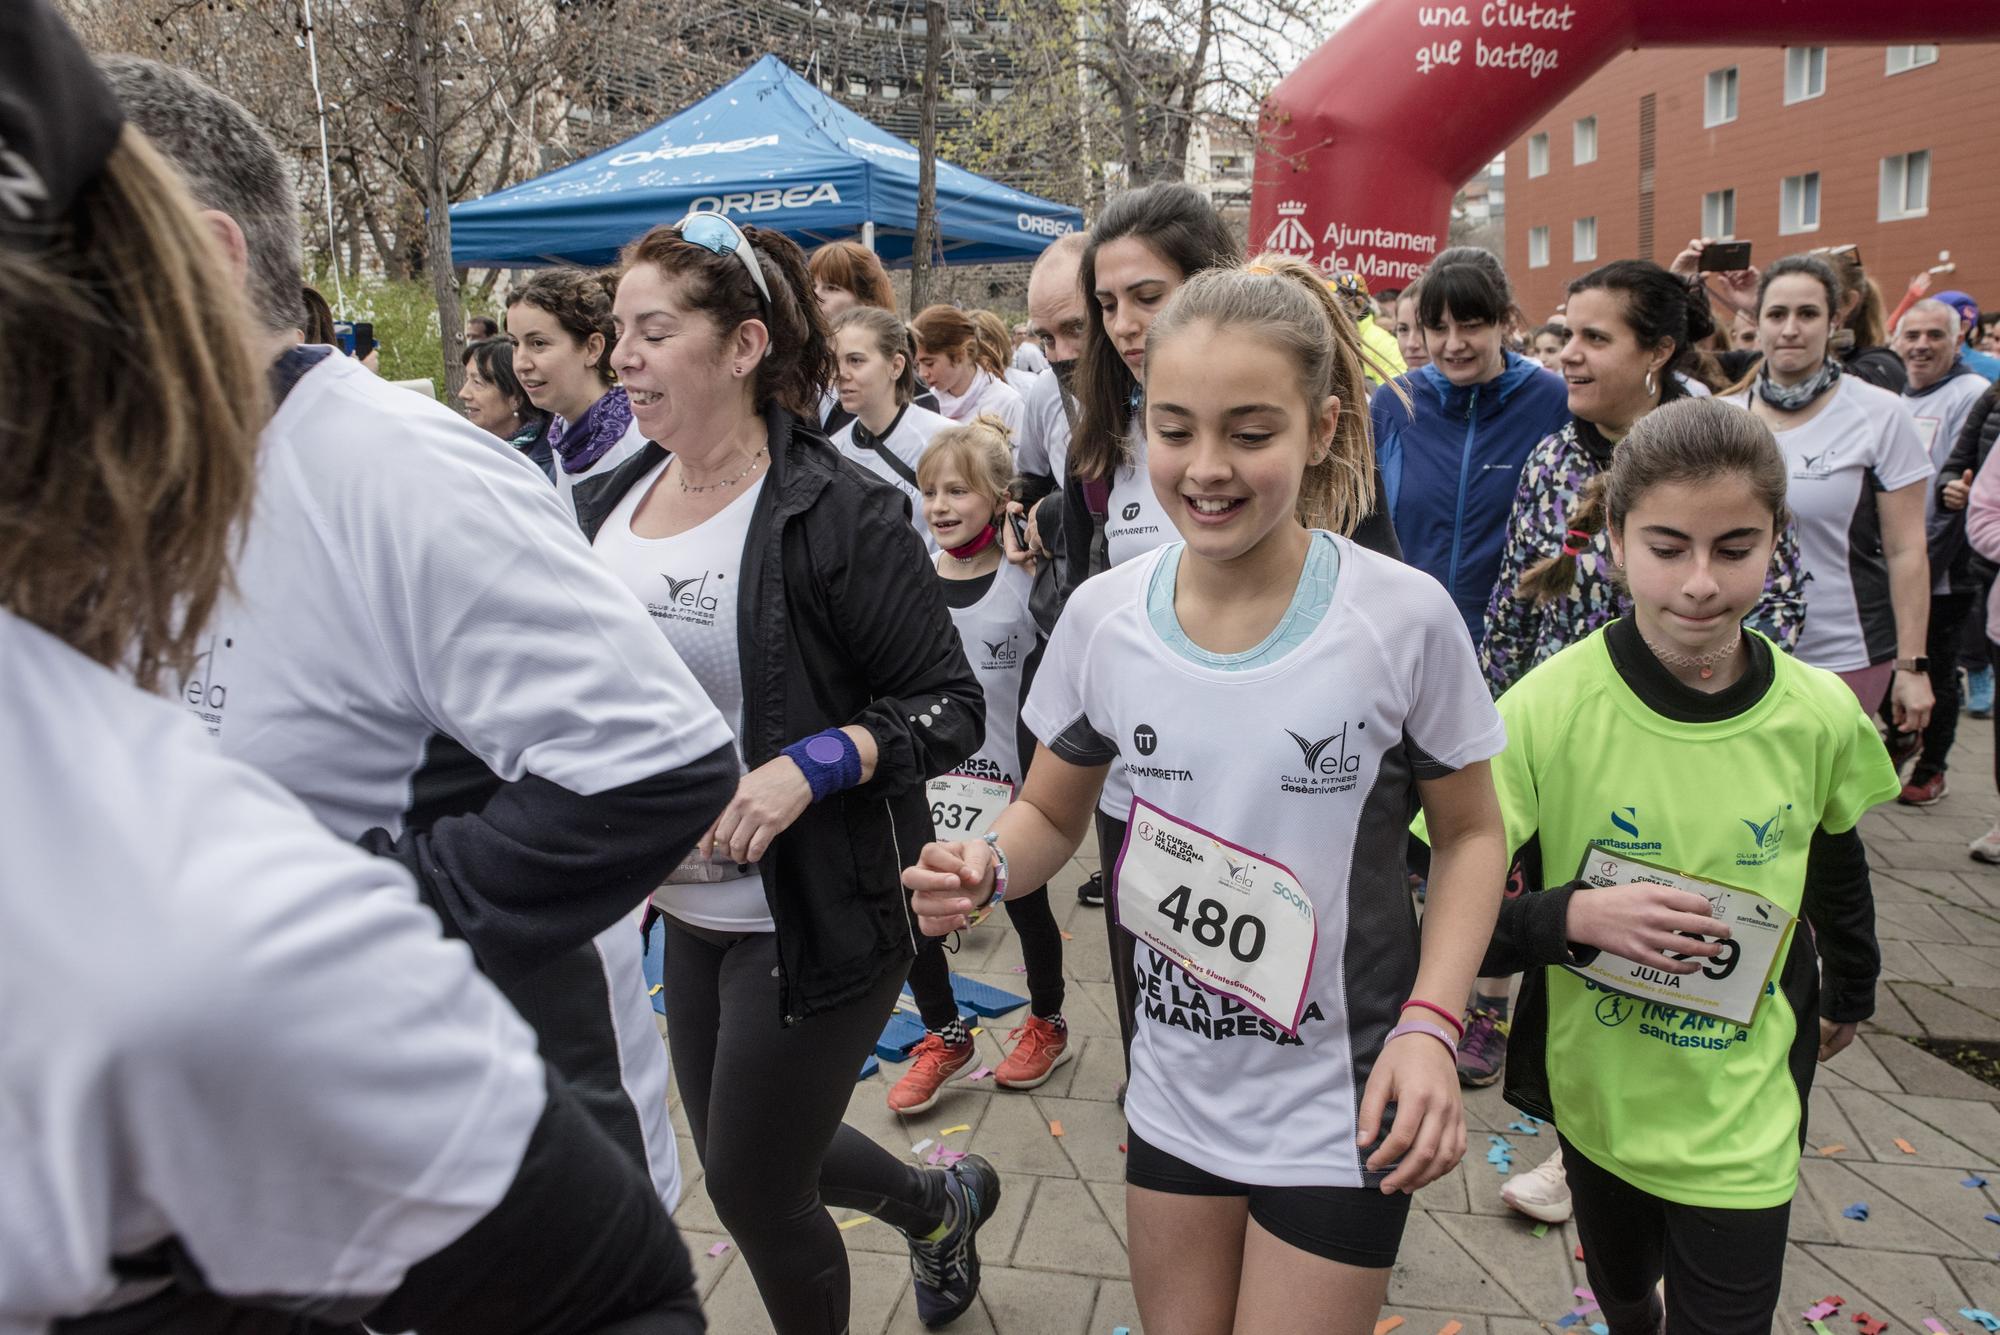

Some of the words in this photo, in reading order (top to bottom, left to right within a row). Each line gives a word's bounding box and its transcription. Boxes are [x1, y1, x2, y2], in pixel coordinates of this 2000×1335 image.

[1419, 6, 1471, 27] una
[1481, 0, 1576, 30] ciutat
[1416, 39, 1462, 74] que
[1475, 37, 1559, 78] batega
[608, 134, 779, 167] ORBEA
[688, 182, 842, 216] ORBEA
[1017, 213, 1077, 237] ORBEA
[1322, 222, 1437, 254] Ajuntament
[1320, 250, 1349, 272] de
[1355, 253, 1432, 281] Manres
[679, 607, 715, 619] FITNESS
[187, 634, 227, 710] ela
[1284, 720, 1361, 775] Vela
[1280, 774, 1308, 785] CLUB
[1310, 777, 1319, 785] &
[1321, 774, 1358, 785] FITNESS
[930, 801, 983, 832] 637
[1154, 840, 1193, 864] MANRESA
[1155, 834, 1167, 845] DE
[1167, 841, 1178, 851] LA
[1180, 846, 1204, 863] DONA
[1158, 828, 1166, 838] VI
[1166, 834, 1194, 852] CURSA
[1157, 884, 1266, 963] 480
[1205, 967, 1267, 1004] #JuntesGuanyem
[1630, 965, 1681, 989] JULIA
[1171, 984, 1212, 1018] LA
[1144, 995, 1305, 1047] MANRESA
